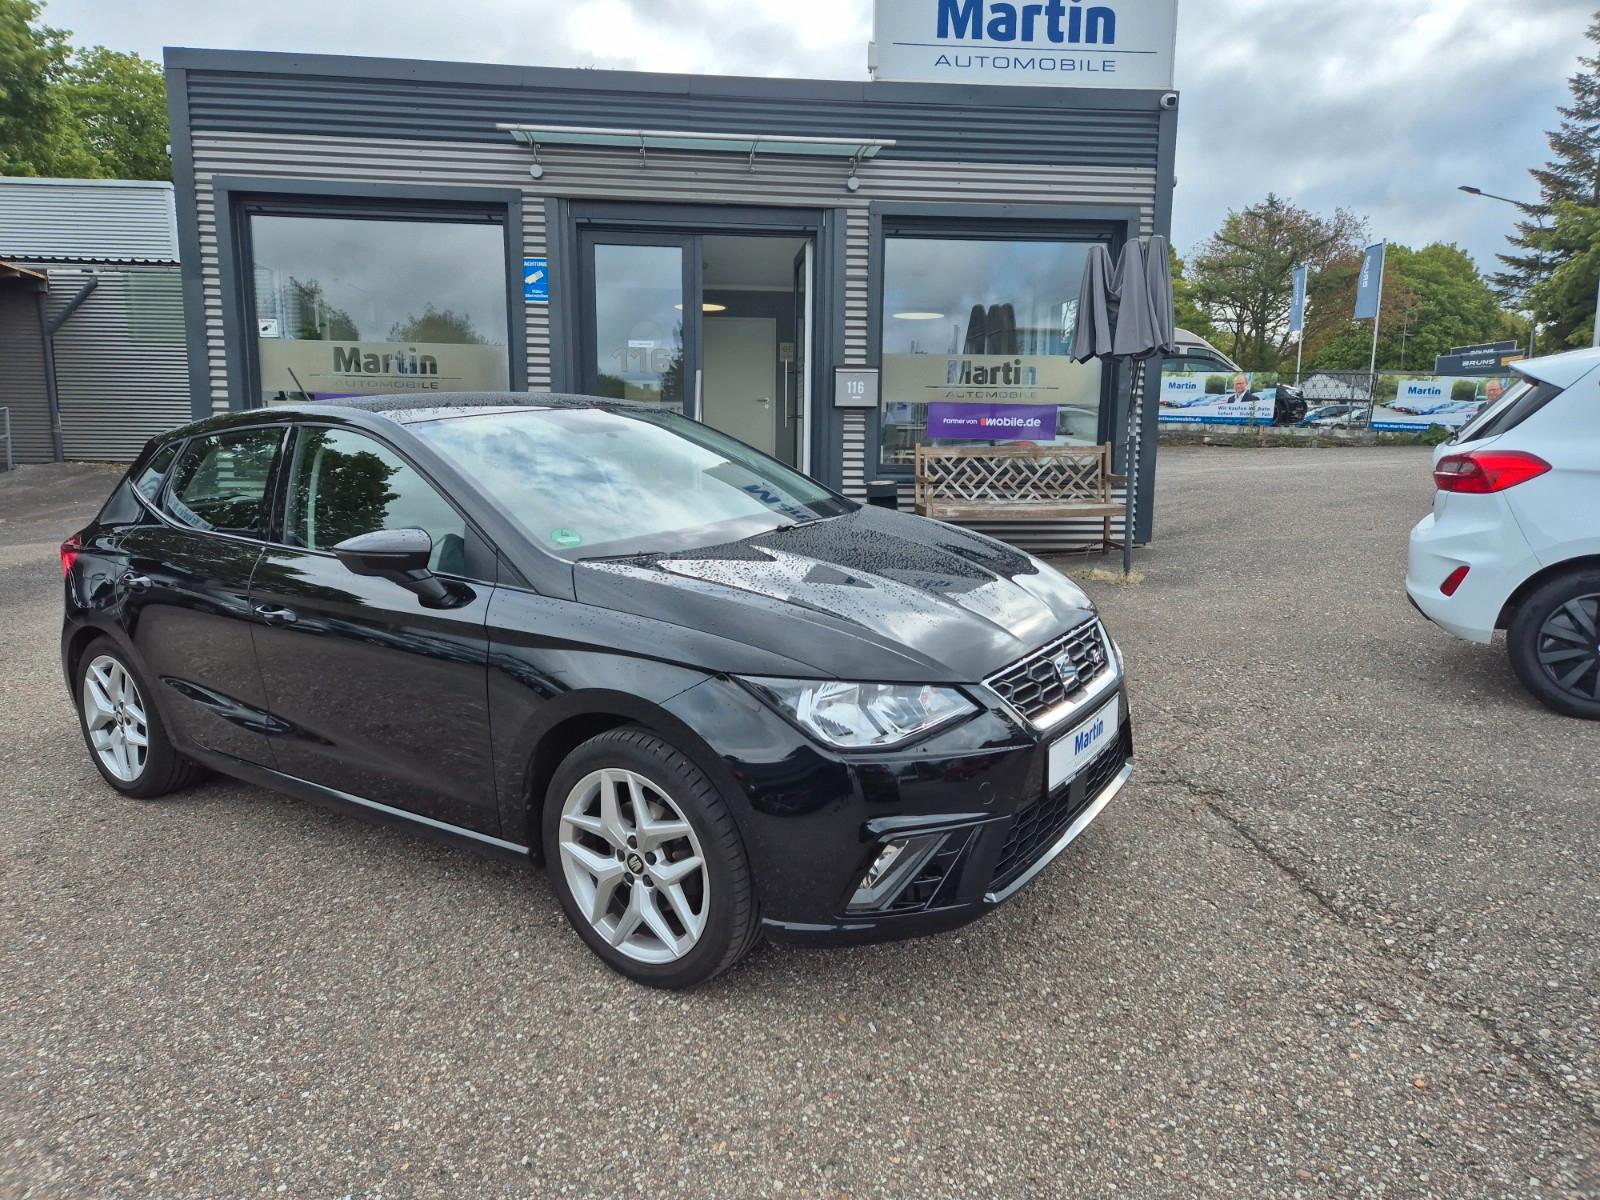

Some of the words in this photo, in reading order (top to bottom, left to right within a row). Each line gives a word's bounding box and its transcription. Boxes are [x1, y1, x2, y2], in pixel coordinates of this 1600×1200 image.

[936, 0, 1116, 45] Martin
[934, 54, 1117, 73] AUTOMOBILE
[333, 347, 438, 375] Martin
[1462, 359, 1495, 367] BRUNS
[946, 358, 1038, 386] Martin
[336, 380, 440, 390] AUTOMOBILE
[847, 380, 865, 394] 116
[1168, 381, 1197, 390] Martin
[1407, 386, 1441, 396] Martin
[944, 390, 1038, 399] AUTOMOBILE
[985, 416, 1042, 428] mobile.de
[1074, 718, 1104, 756] Martin
